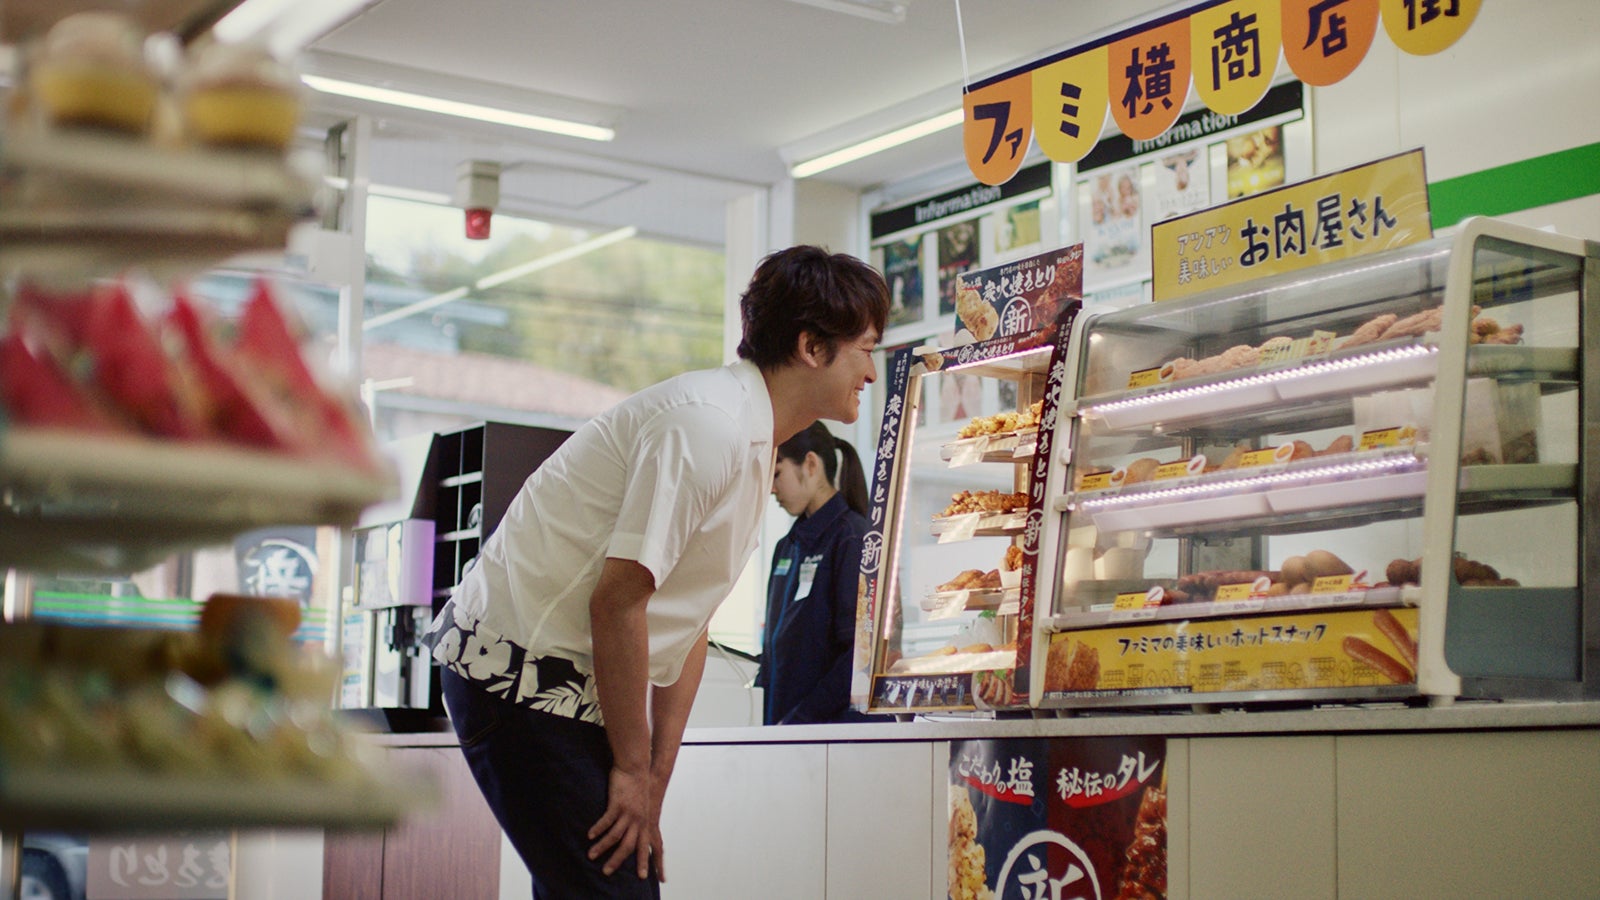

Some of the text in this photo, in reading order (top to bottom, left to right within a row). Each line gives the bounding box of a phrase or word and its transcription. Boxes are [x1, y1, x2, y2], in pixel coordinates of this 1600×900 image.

[915, 186, 1002, 223] Information
[1177, 224, 1232, 256] アツアツ
[1239, 195, 1397, 269] お肉屋さん
[982, 264, 1056, 304] 炭火焼きとり
[1177, 255, 1233, 285] 美味しい
[1003, 303, 1028, 337] 新
[871, 394, 902, 527] 炭火焼きとり
[860, 538, 882, 567] 新
[1118, 623, 1327, 657] ファミマの美味しいホットスナック
[958, 754, 1035, 798] こだわりの塩
[1056, 751, 1160, 800] 秘伝のタレ
